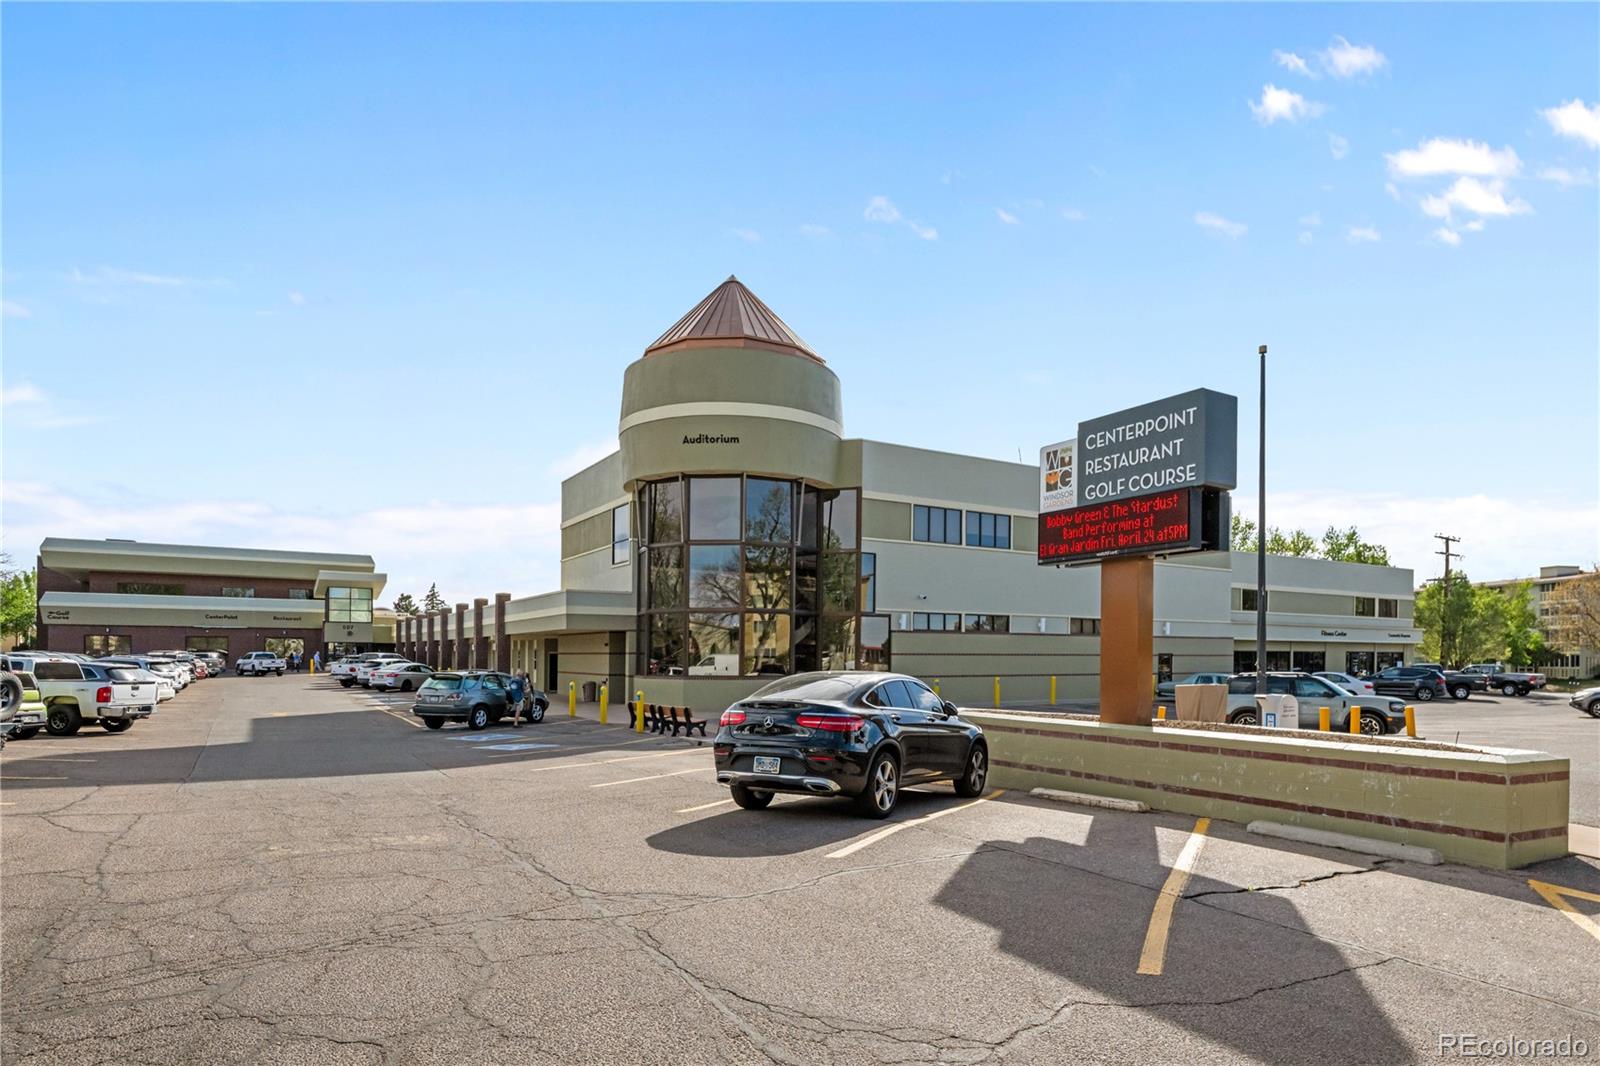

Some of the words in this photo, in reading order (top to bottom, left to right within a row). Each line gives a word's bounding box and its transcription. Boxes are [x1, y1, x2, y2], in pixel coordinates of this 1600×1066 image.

[682, 433, 740, 444] Auditorium
[1085, 406, 1197, 450] CENTERPOINT
[1085, 438, 1184, 476] RESTAURANT
[1085, 478, 1126, 500] GOLF
[1128, 463, 1196, 492] COURSE
[1046, 514, 1073, 529] Bobby
[1075, 510, 1102, 523] Green
[1112, 503, 1129, 518] The
[1131, 494, 1179, 514] Stardust
[1063, 526, 1084, 540] Band
[1085, 517, 1141, 536] Performing
[1143, 513, 1154, 528] at
[1071, 538, 1100, 553] Jardin
[1118, 529, 1141, 547] April
[1143, 529, 1155, 543] 24
